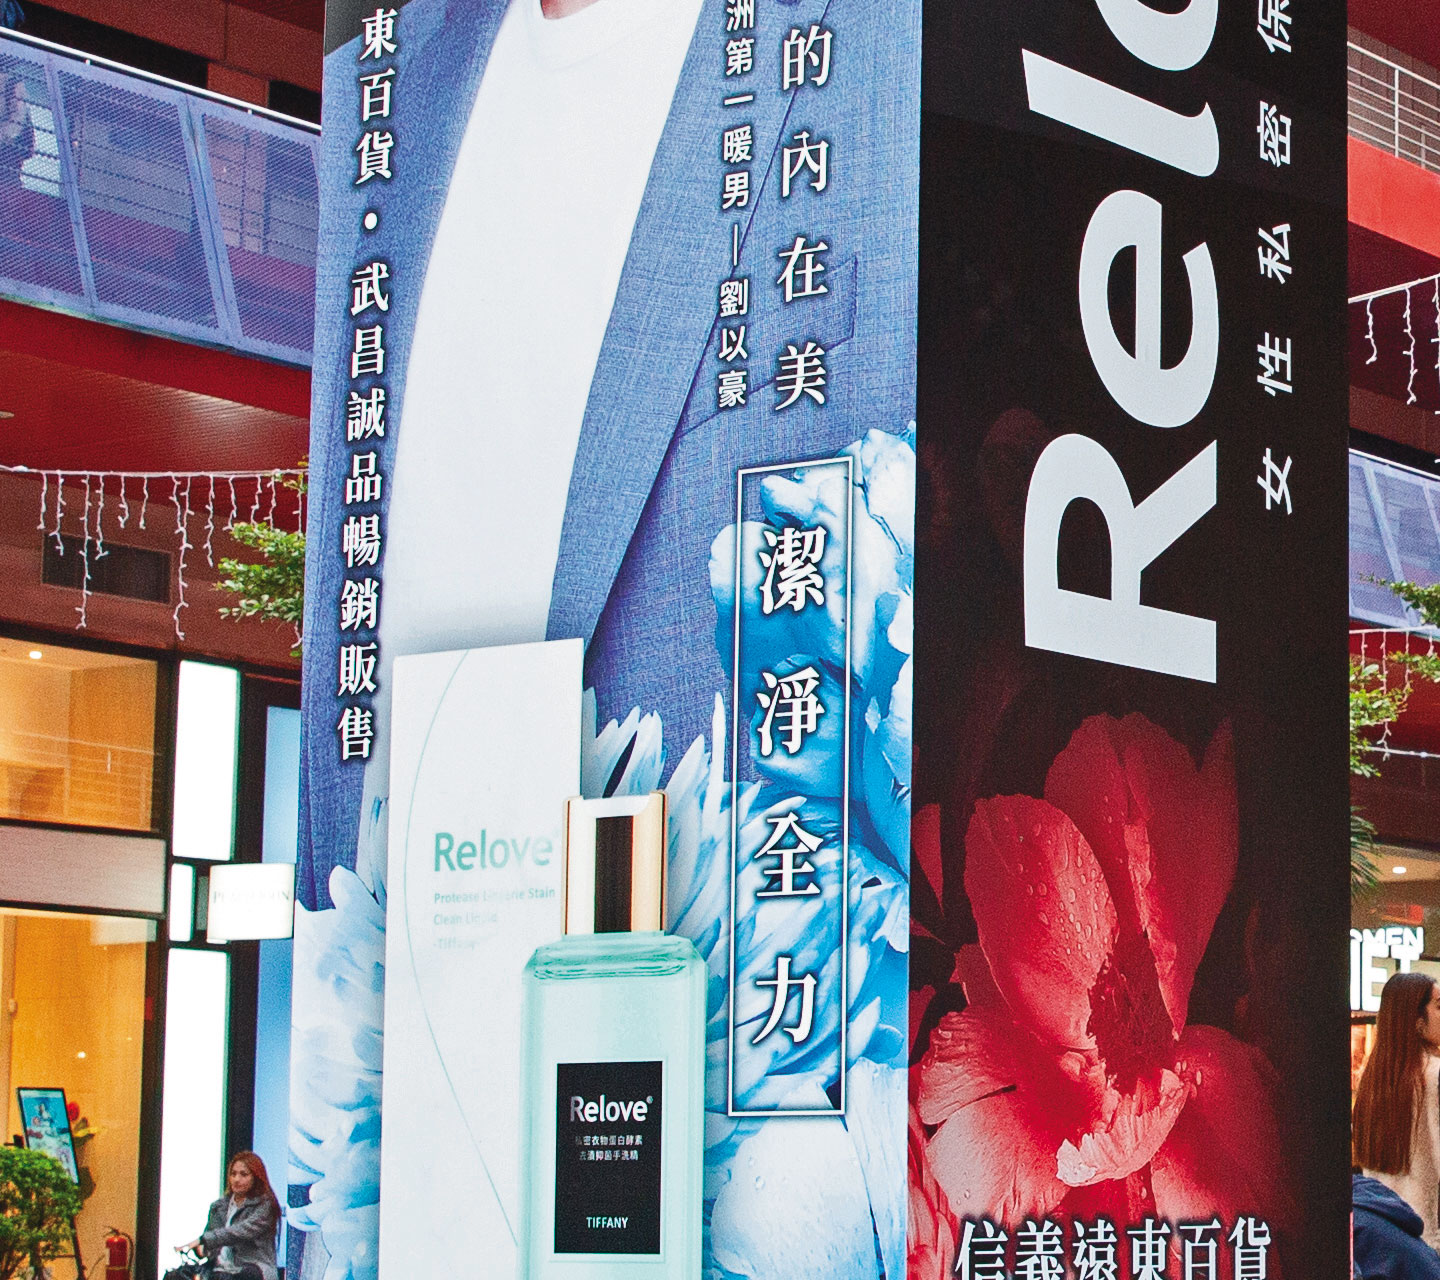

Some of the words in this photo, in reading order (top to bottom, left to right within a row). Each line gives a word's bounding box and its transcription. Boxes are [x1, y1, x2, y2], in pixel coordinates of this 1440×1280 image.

[753, 524, 828, 1046] 潔淨全力
[586, 1216, 629, 1229] TIFFANY
